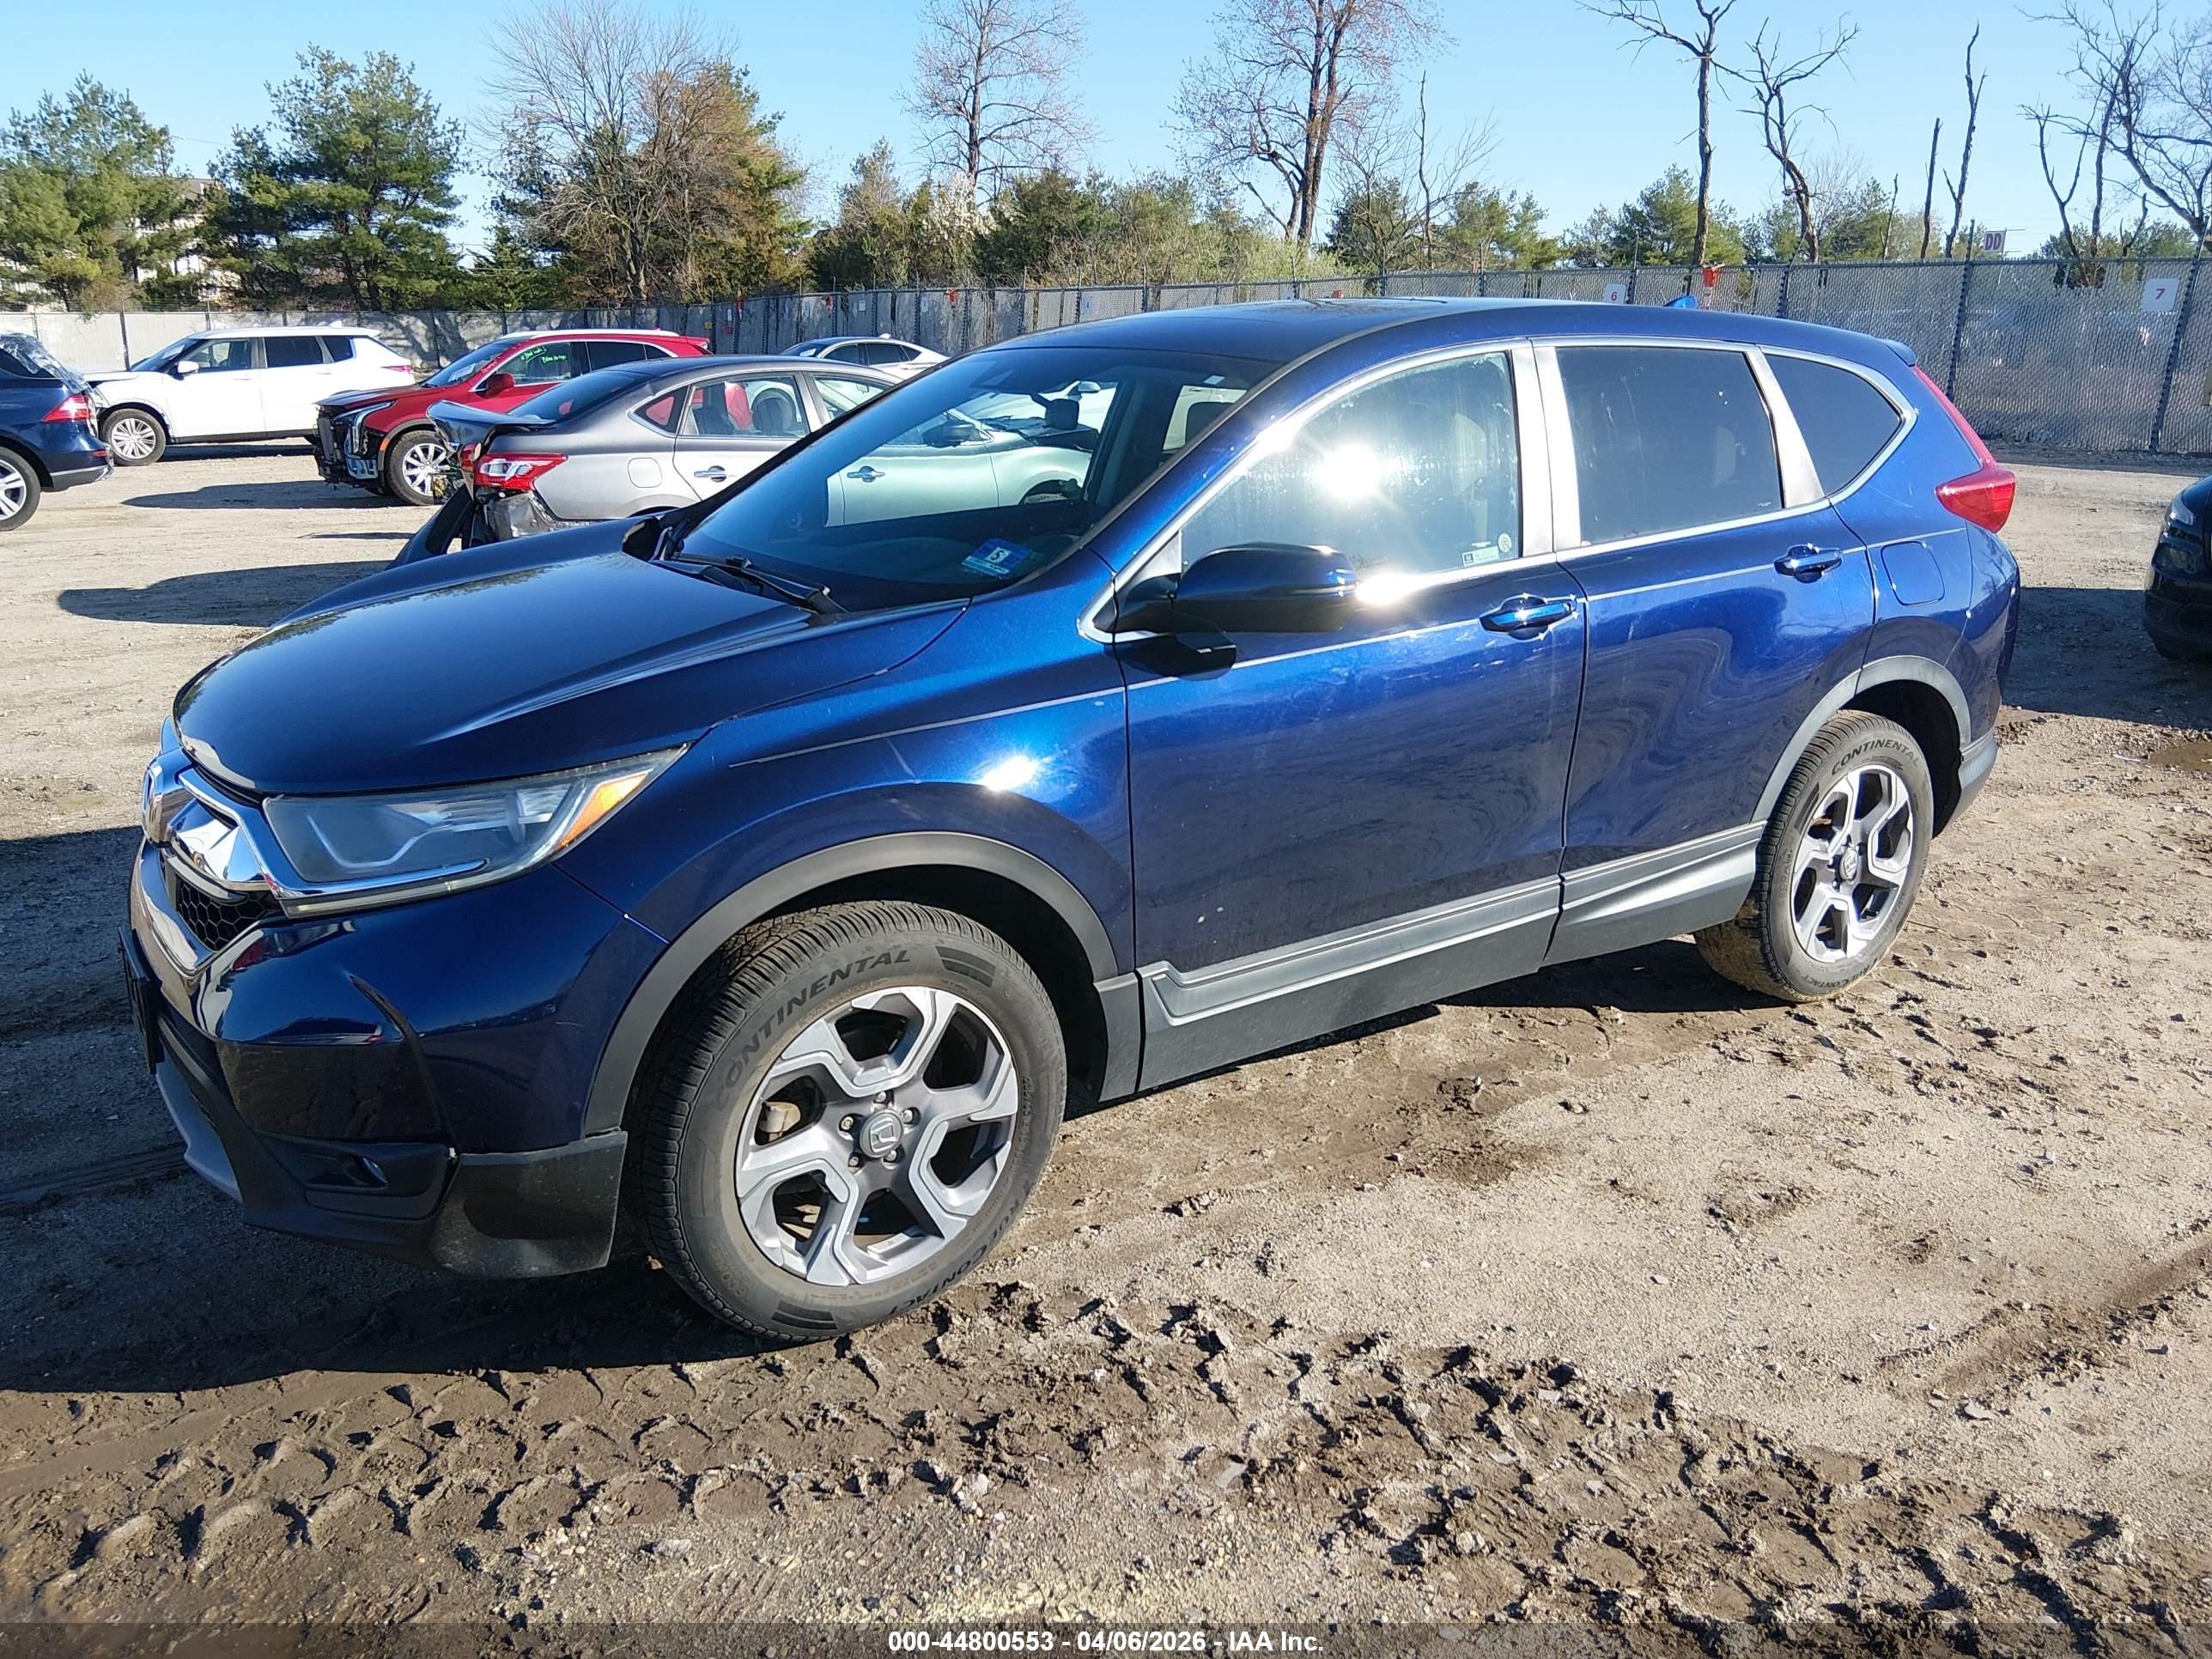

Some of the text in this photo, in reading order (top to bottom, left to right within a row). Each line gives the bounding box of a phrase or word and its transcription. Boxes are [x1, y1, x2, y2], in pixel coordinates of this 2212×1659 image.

[1610, 291, 1618, 301] 6
[2155, 288, 2166, 300] 7
[1831, 738, 1921, 775] CONTINENTAL
[714, 949, 911, 1111] CONTINENTAL
